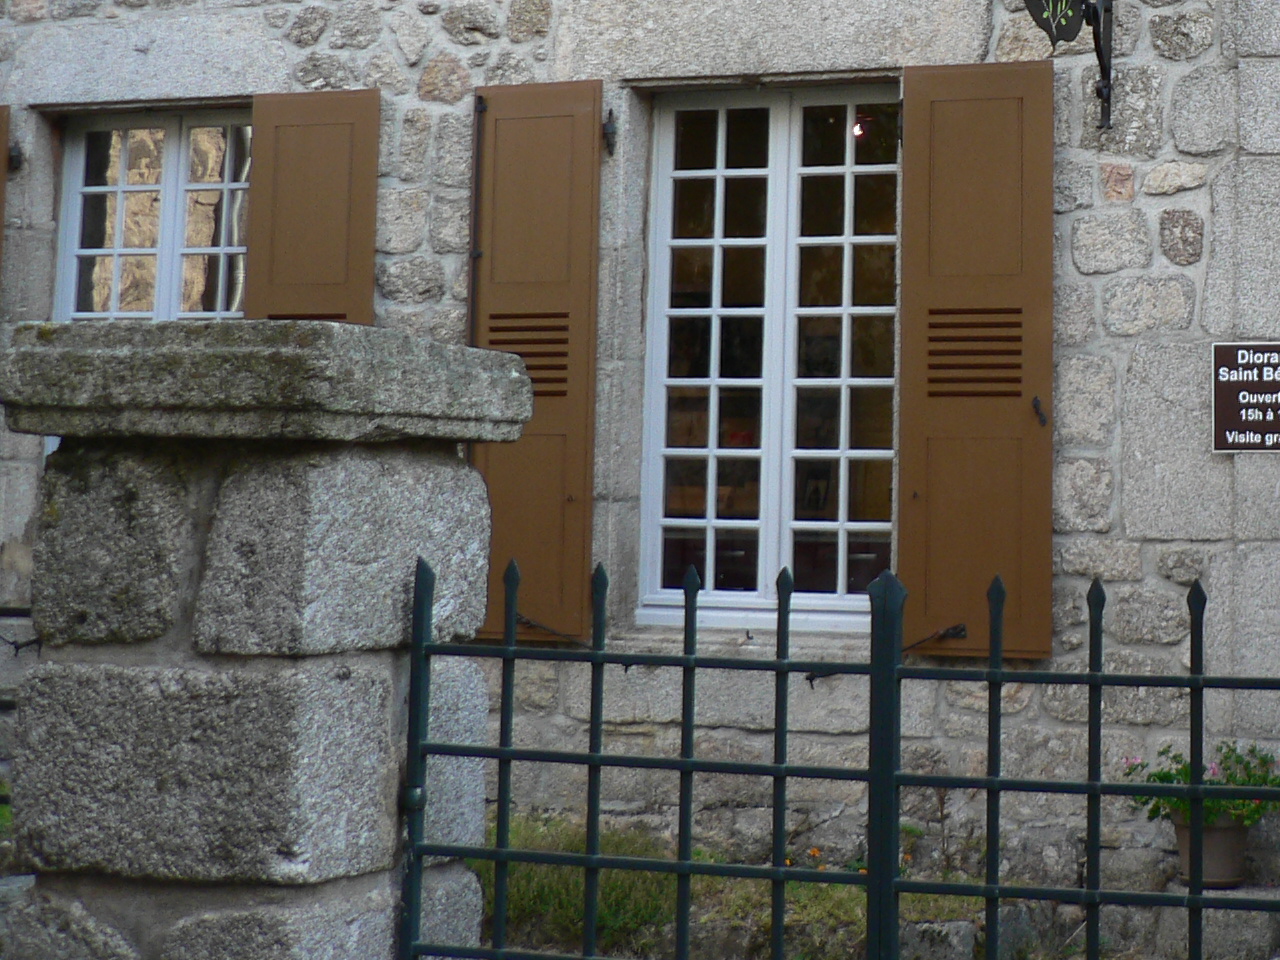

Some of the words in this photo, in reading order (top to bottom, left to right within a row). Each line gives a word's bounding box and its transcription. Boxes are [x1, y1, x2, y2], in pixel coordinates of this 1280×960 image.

[1218, 367, 1259, 381] Saint
[1240, 408, 1263, 420] 15h
[1266, 408, 1274, 420] à
[1225, 431, 1262, 444] Visite
